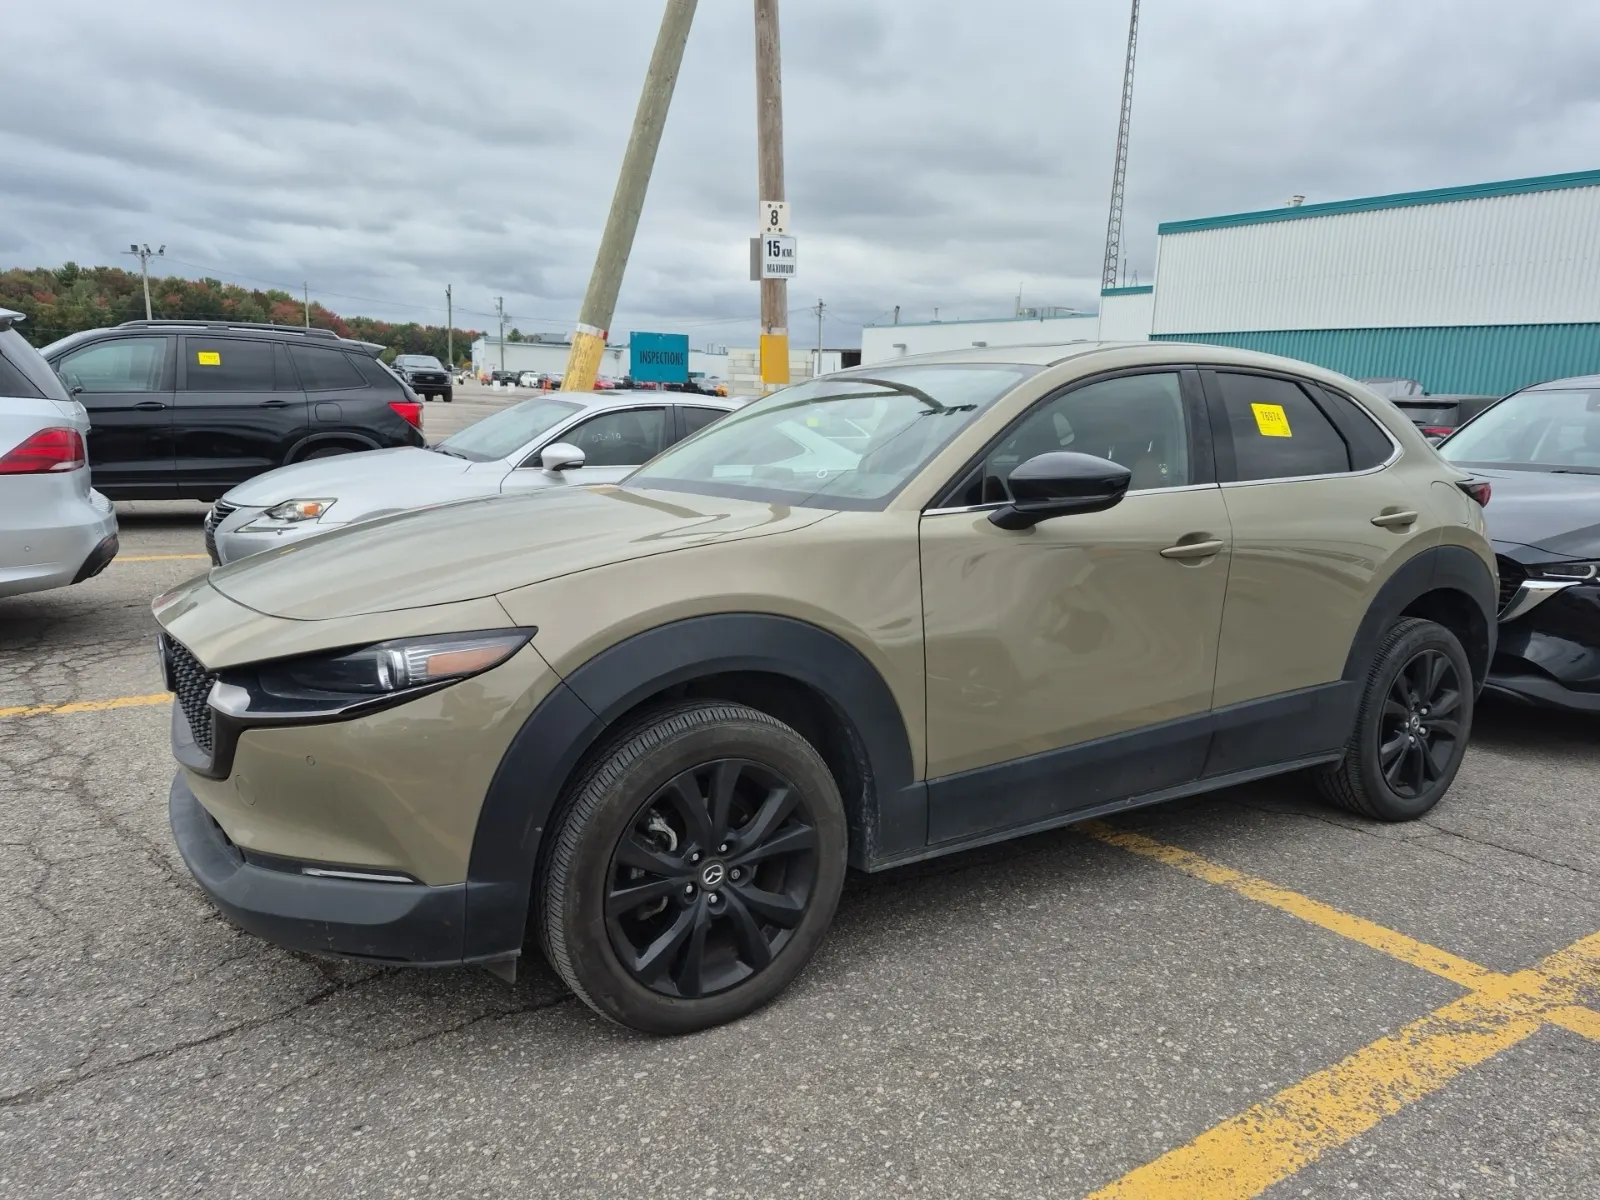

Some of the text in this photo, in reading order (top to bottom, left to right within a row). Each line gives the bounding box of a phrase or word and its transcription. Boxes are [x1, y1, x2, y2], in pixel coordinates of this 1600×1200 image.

[770, 209, 779, 226] 8
[767, 240, 780, 257] 15
[766, 263, 794, 274] MAXIMUM
[639, 350, 684, 366] INSPECTIONS
